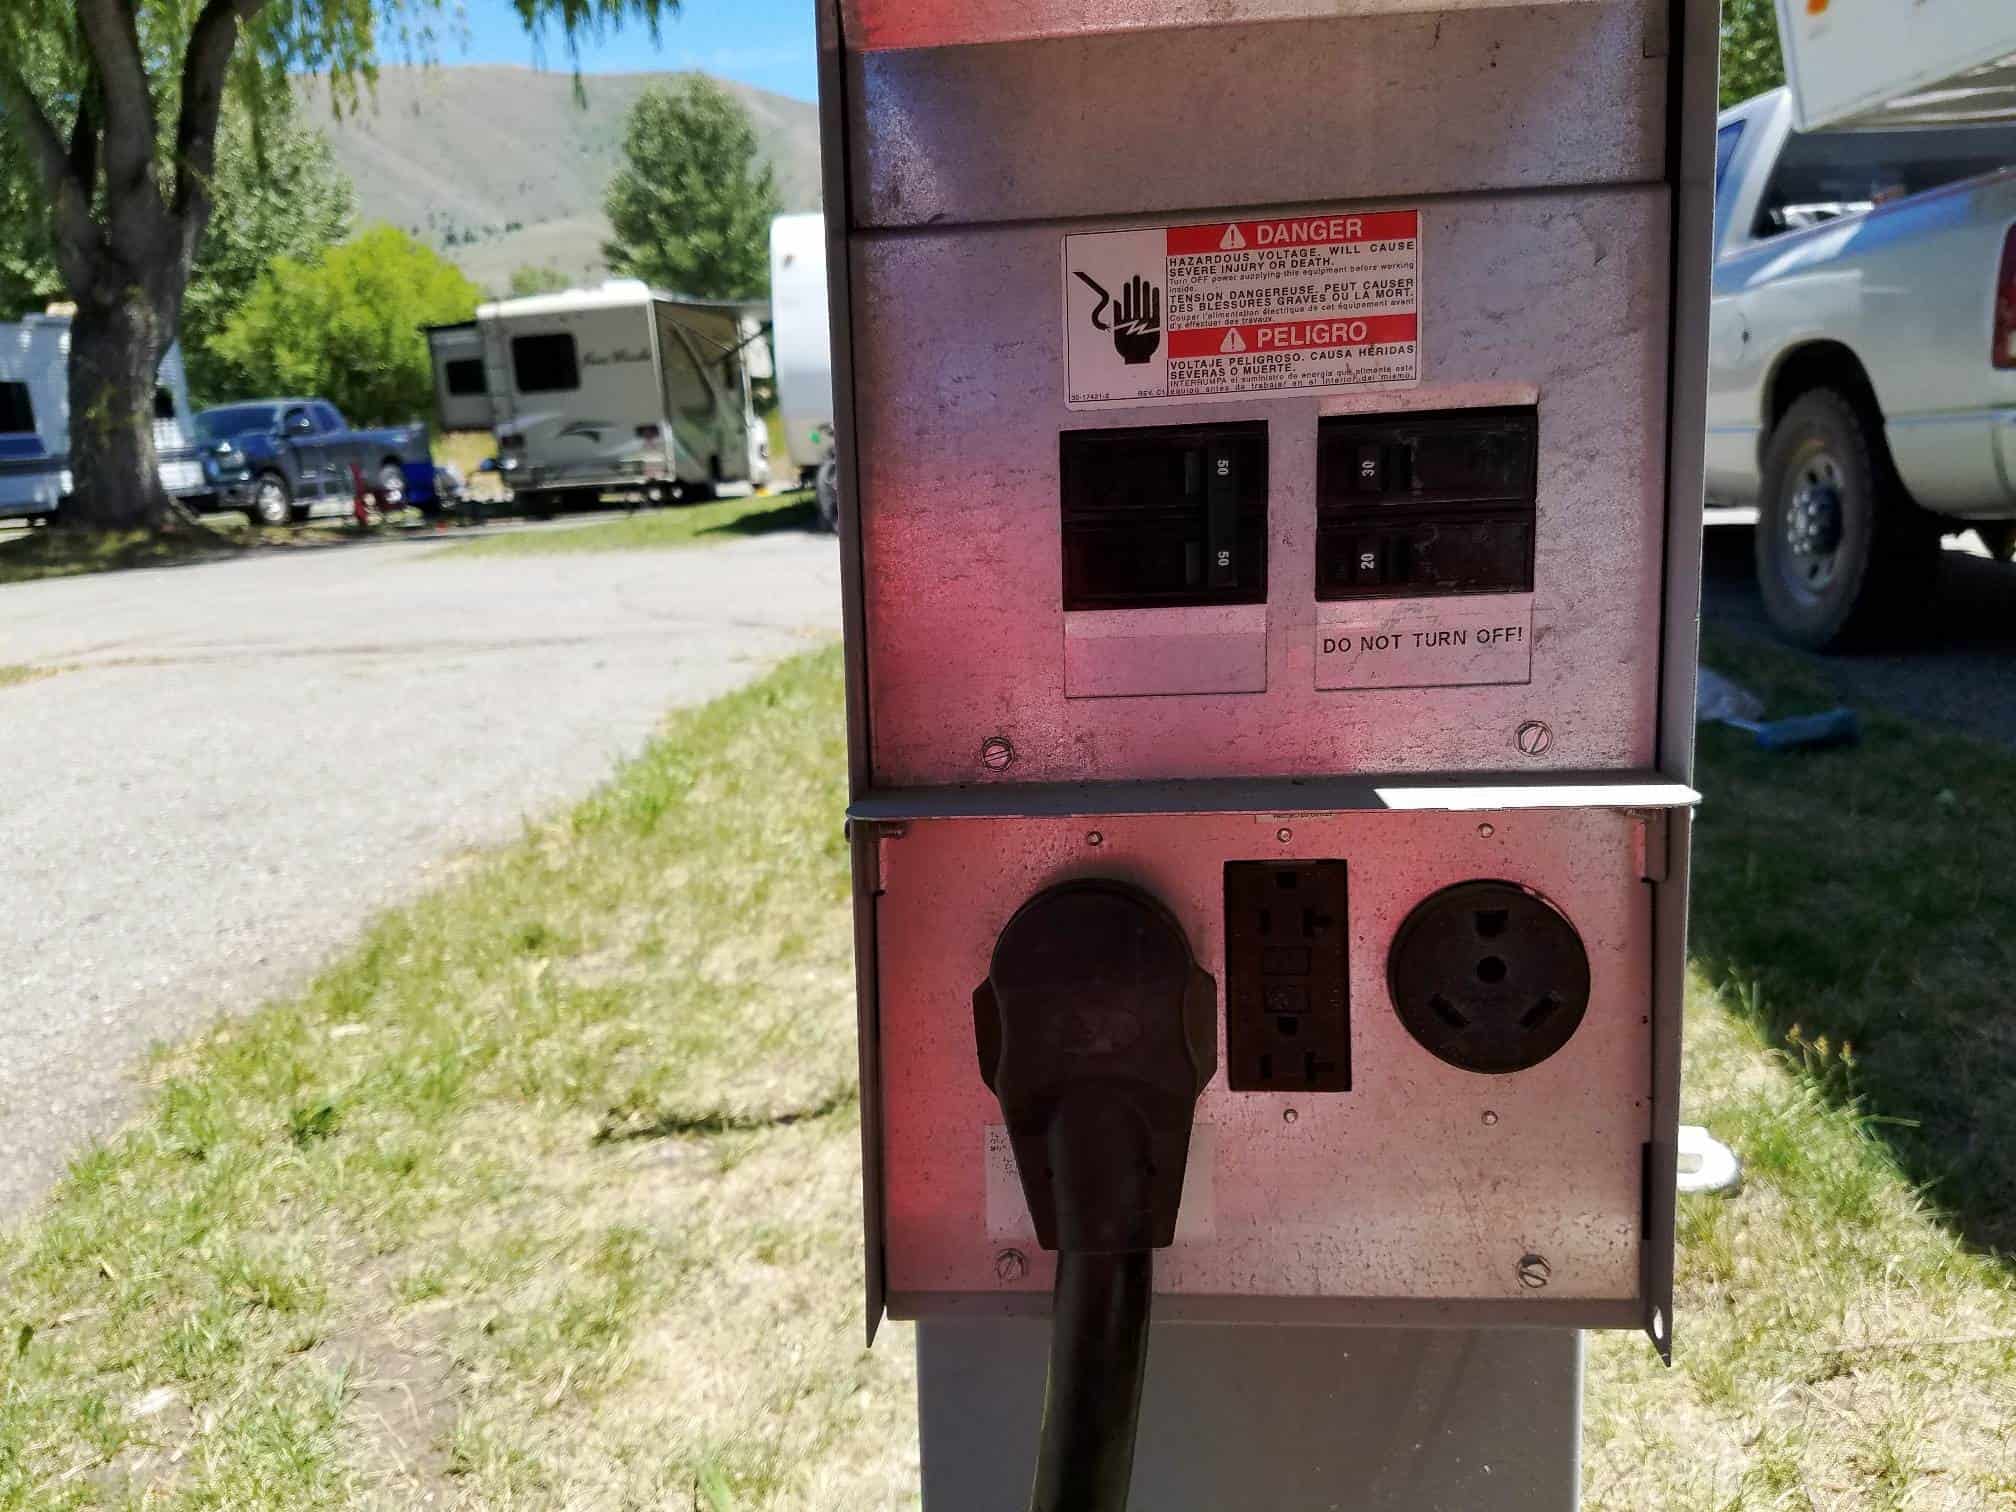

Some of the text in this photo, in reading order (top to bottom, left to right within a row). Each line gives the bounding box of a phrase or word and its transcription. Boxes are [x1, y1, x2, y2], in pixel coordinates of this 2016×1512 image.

[1256, 218, 1362, 244] DANGER
[1169, 241, 1415, 267] HAZARDOUS VOLTAGE. WILL CAUSE
[1169, 257, 1334, 277] SEVERE INJURY OR DEATH.
[1169, 278, 1187, 286] Turn
[1190, 275, 1209, 284] OFF
[1169, 278, 1414, 304] TENSION DANGEREUSE. PEUT CAUSER
[1169, 287, 1414, 313] DES BLESSURES GRAVES OU LA MORT.
[1257, 321, 1367, 349] PELIGRO
[1170, 358, 1223, 370] VOLTAJE
[1229, 352, 1305, 367] PELIGROSO.
[1310, 349, 1353, 361] CAUSA
[1170, 363, 1297, 380] SEVERAS O MUERTE.
[1217, 459, 1229, 476] 50
[1361, 460, 1375, 477] 30
[1217, 551, 1230, 566] 50
[1360, 553, 1375, 570] 20
[1323, 627, 1523, 653] DO NOT TURN OFF!
